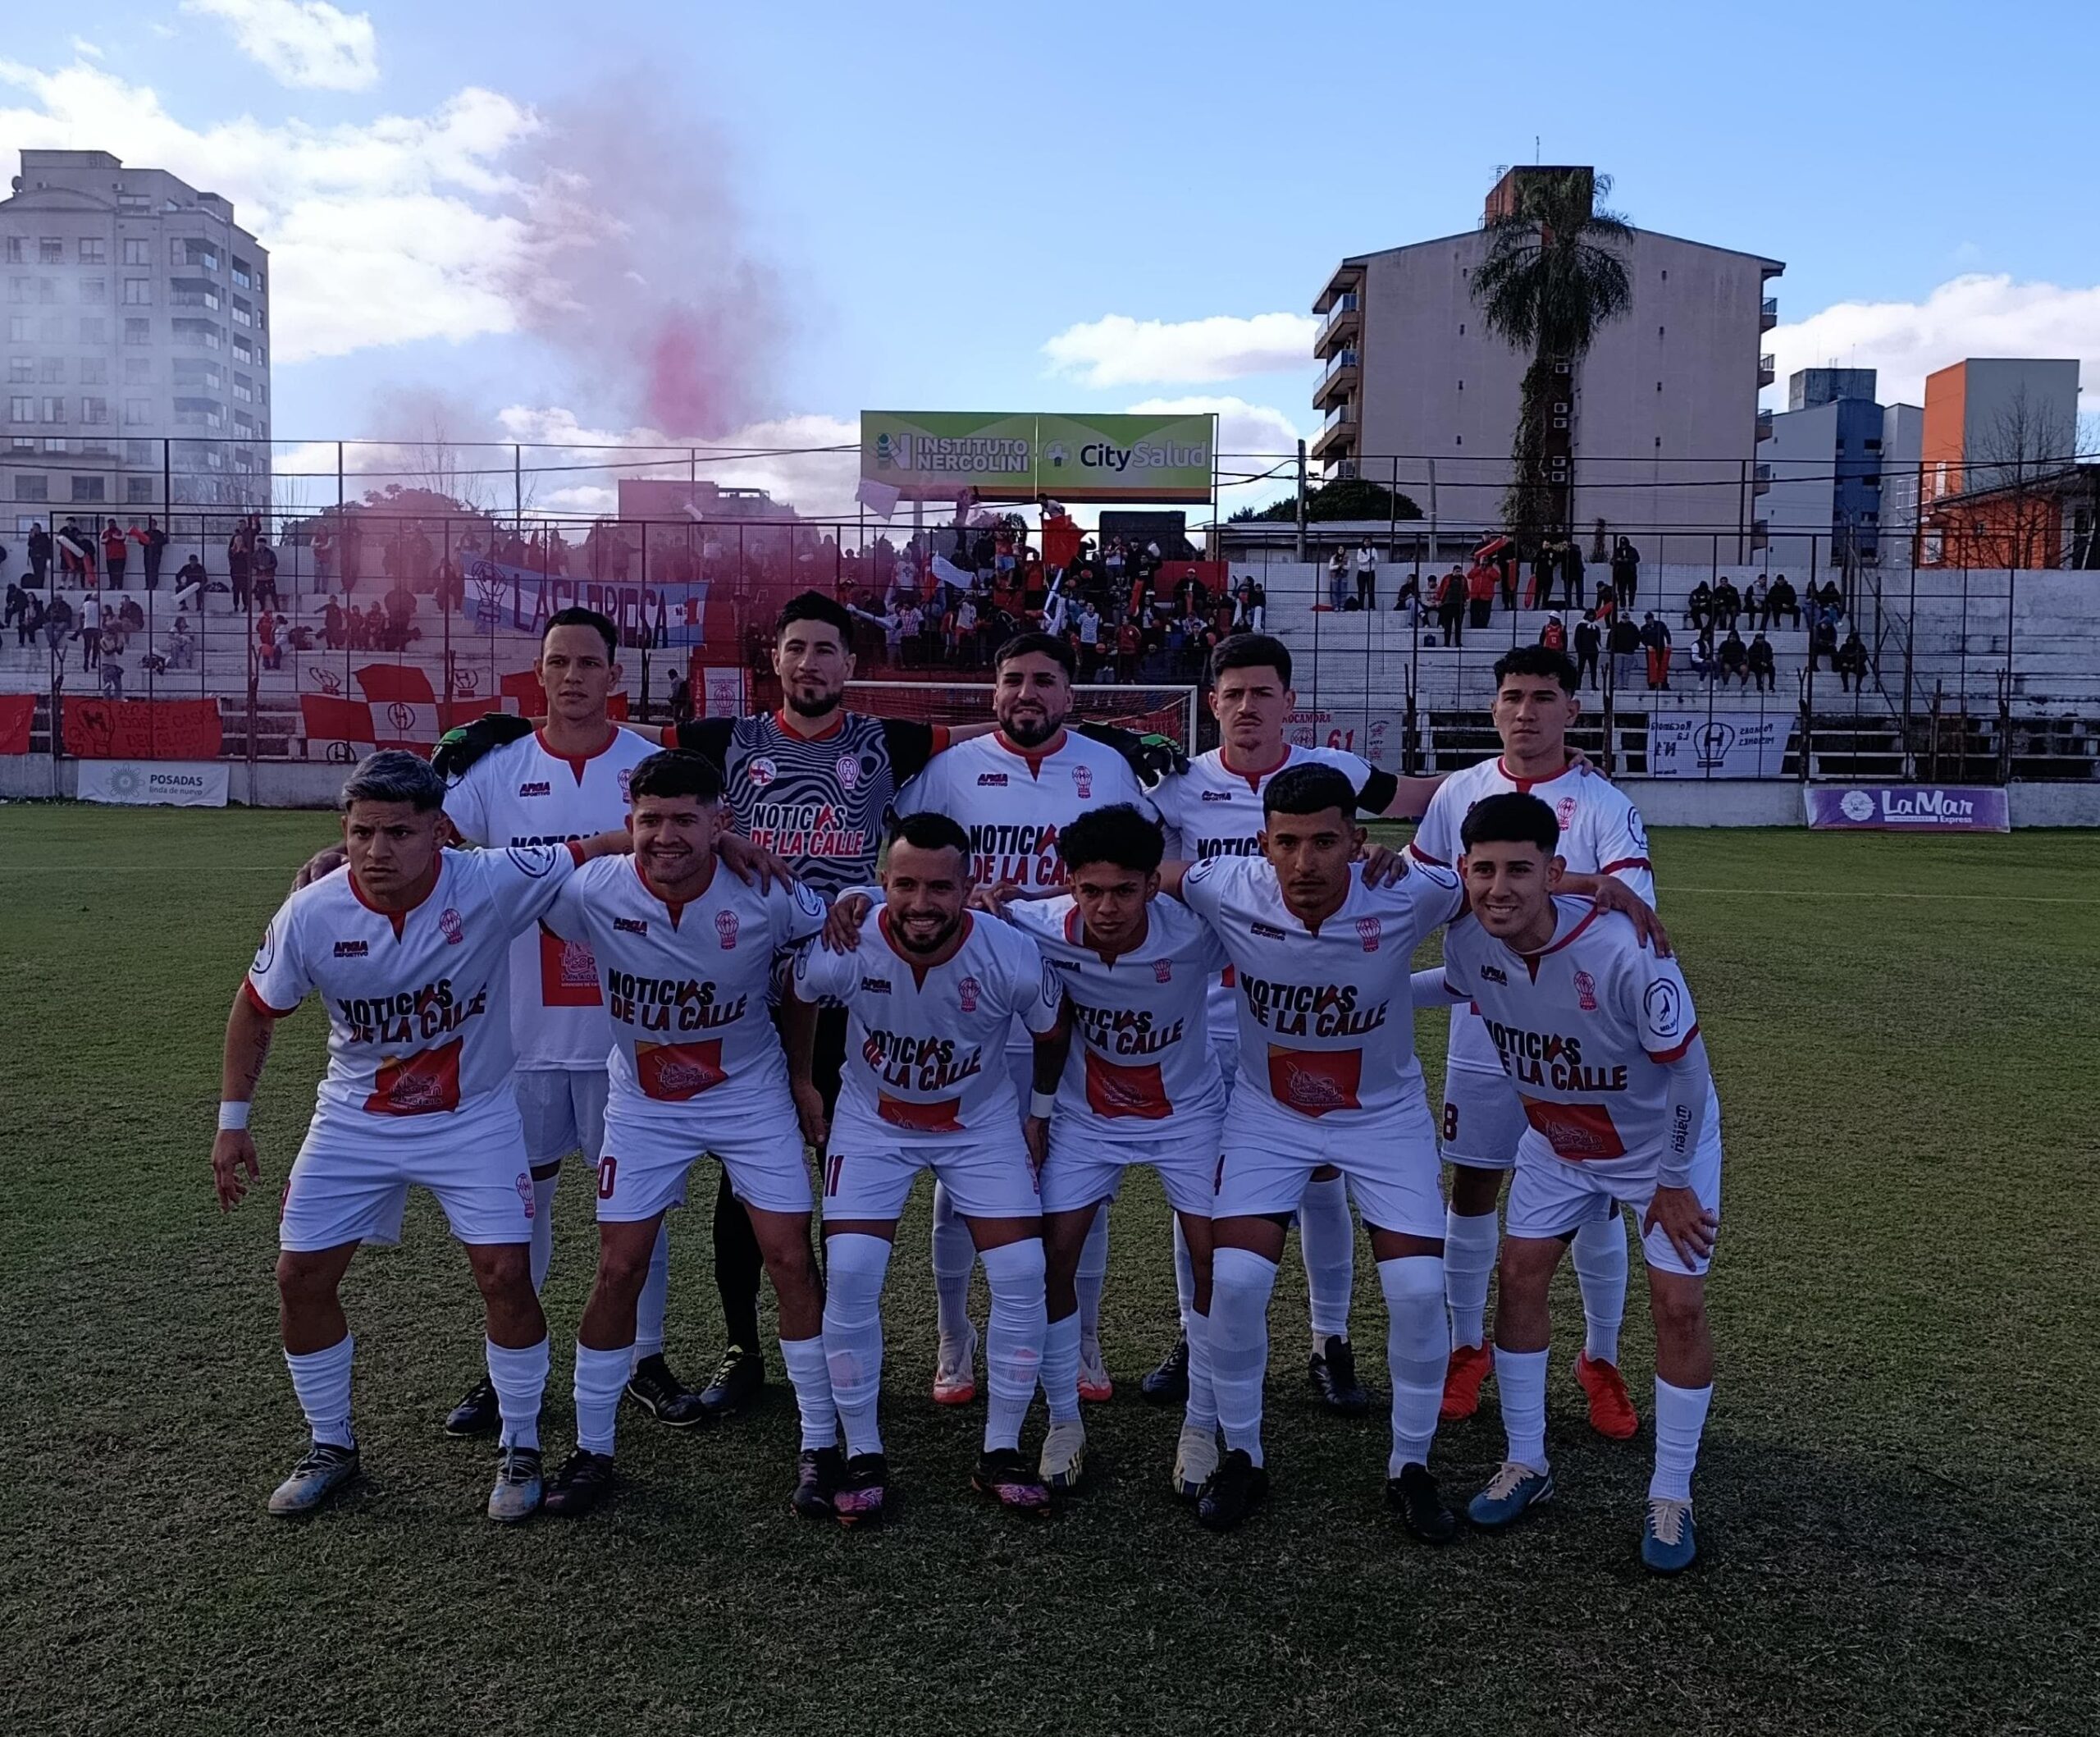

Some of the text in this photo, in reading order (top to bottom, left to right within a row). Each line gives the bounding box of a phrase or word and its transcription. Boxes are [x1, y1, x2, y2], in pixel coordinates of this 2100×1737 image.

[916, 437, 1029, 456] INSTITUTO
[916, 454, 1029, 473] NERCOLINI
[1327, 729, 1354, 752] 61
[149, 774, 203, 786] POSADAS
[149, 785, 203, 795] linda de nuevo
[752, 802, 847, 831] NOTICIAS
[1940, 815, 1972, 824] Express
[777, 830, 803, 855] LA
[809, 830, 865, 856] CALLE
[970, 823, 1070, 857] NOTICIA
[1197, 837, 1265, 861] NOTIC
[973, 854, 996, 884] DE
[1001, 855, 1028, 885] LA
[336, 979, 454, 1026] NOTICIAS
[609, 967, 716, 1008] NOTICIAS
[1240, 971, 1358, 1015] NOTICIAS
[610, 992, 747, 1031] DE LA CALLE
[1075, 1003, 1153, 1034] TICIAS
[1249, 997, 1391, 1038] DE LA CALLE
[381, 1016, 413, 1044] LA
[863, 1020, 956, 1067] OTICIAS
[1084, 1017, 1185, 1055] LA CALLE
[883, 1060, 911, 1090] LA
[918, 1044, 982, 1091] CALLE
[1516, 1056, 1545, 1087] LA
[1550, 1063, 1628, 1091] CALLE
[1443, 1102, 1459, 1142] 8
[824, 1154, 845, 1197] 11
